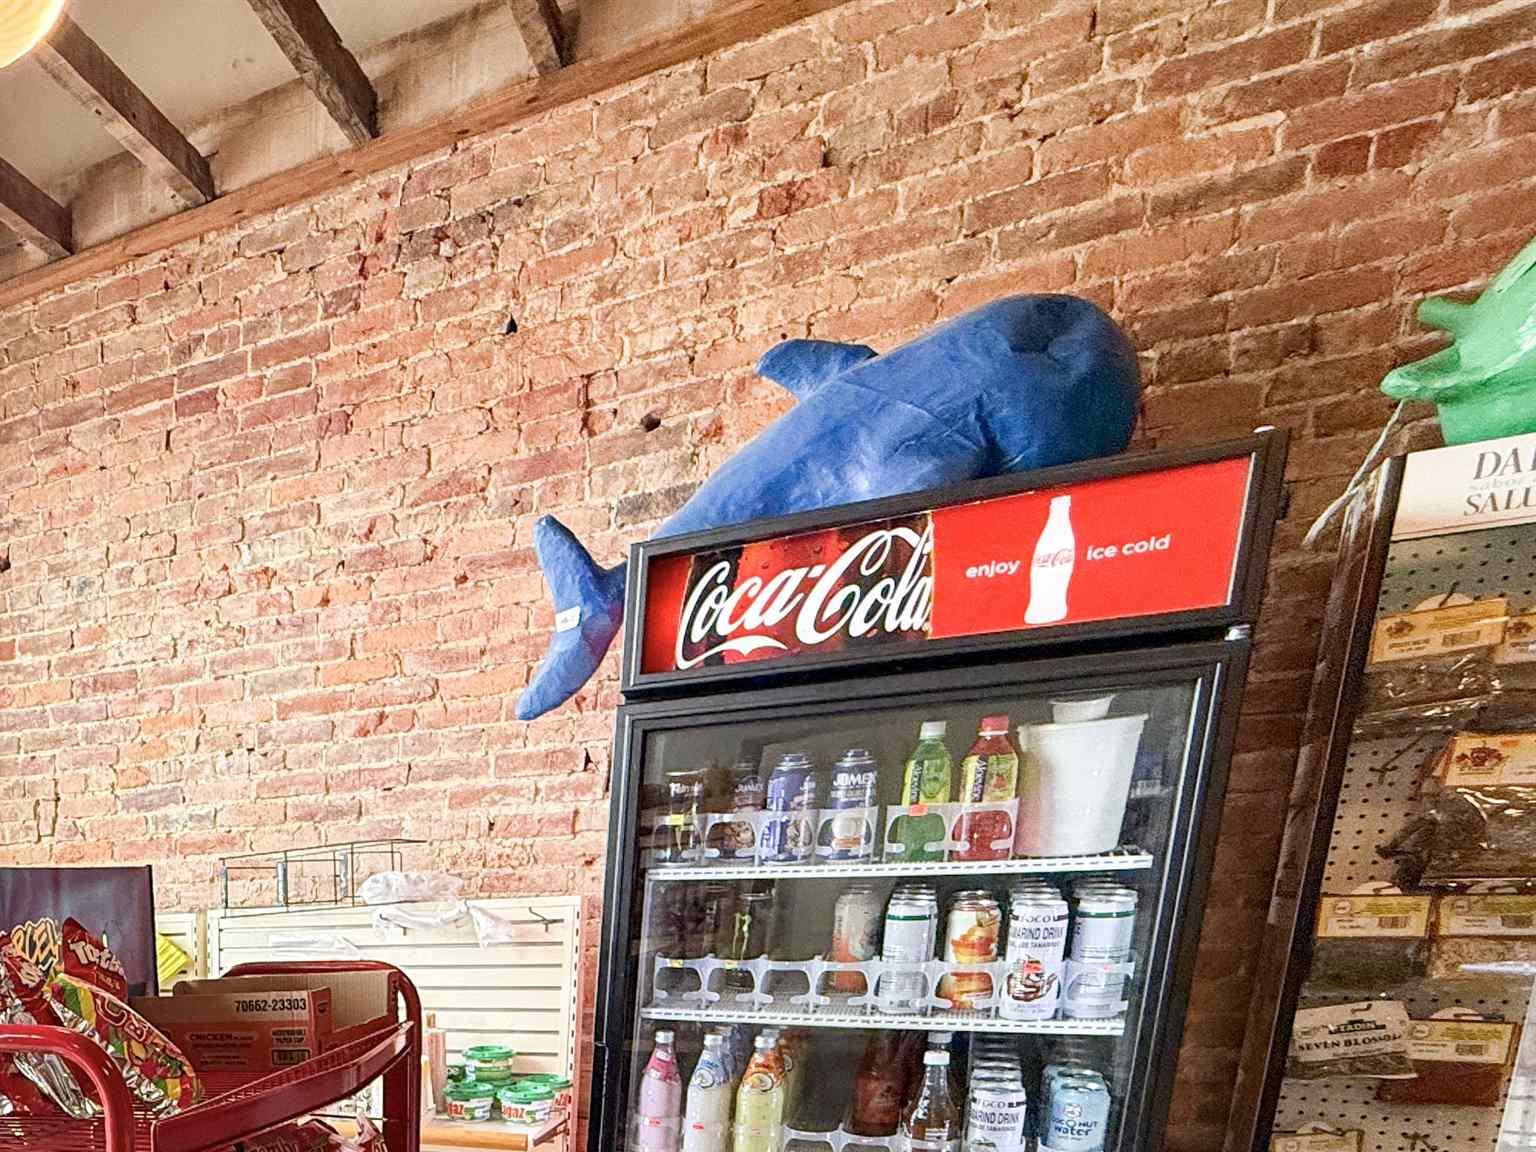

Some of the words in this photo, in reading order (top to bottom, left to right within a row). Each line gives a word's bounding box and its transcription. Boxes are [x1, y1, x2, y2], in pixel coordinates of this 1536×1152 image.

[675, 525, 933, 670] Coca-Cola
[965, 559, 1021, 578] enjoy
[1086, 544, 1118, 561] ice
[1122, 534, 1172, 556] cold
